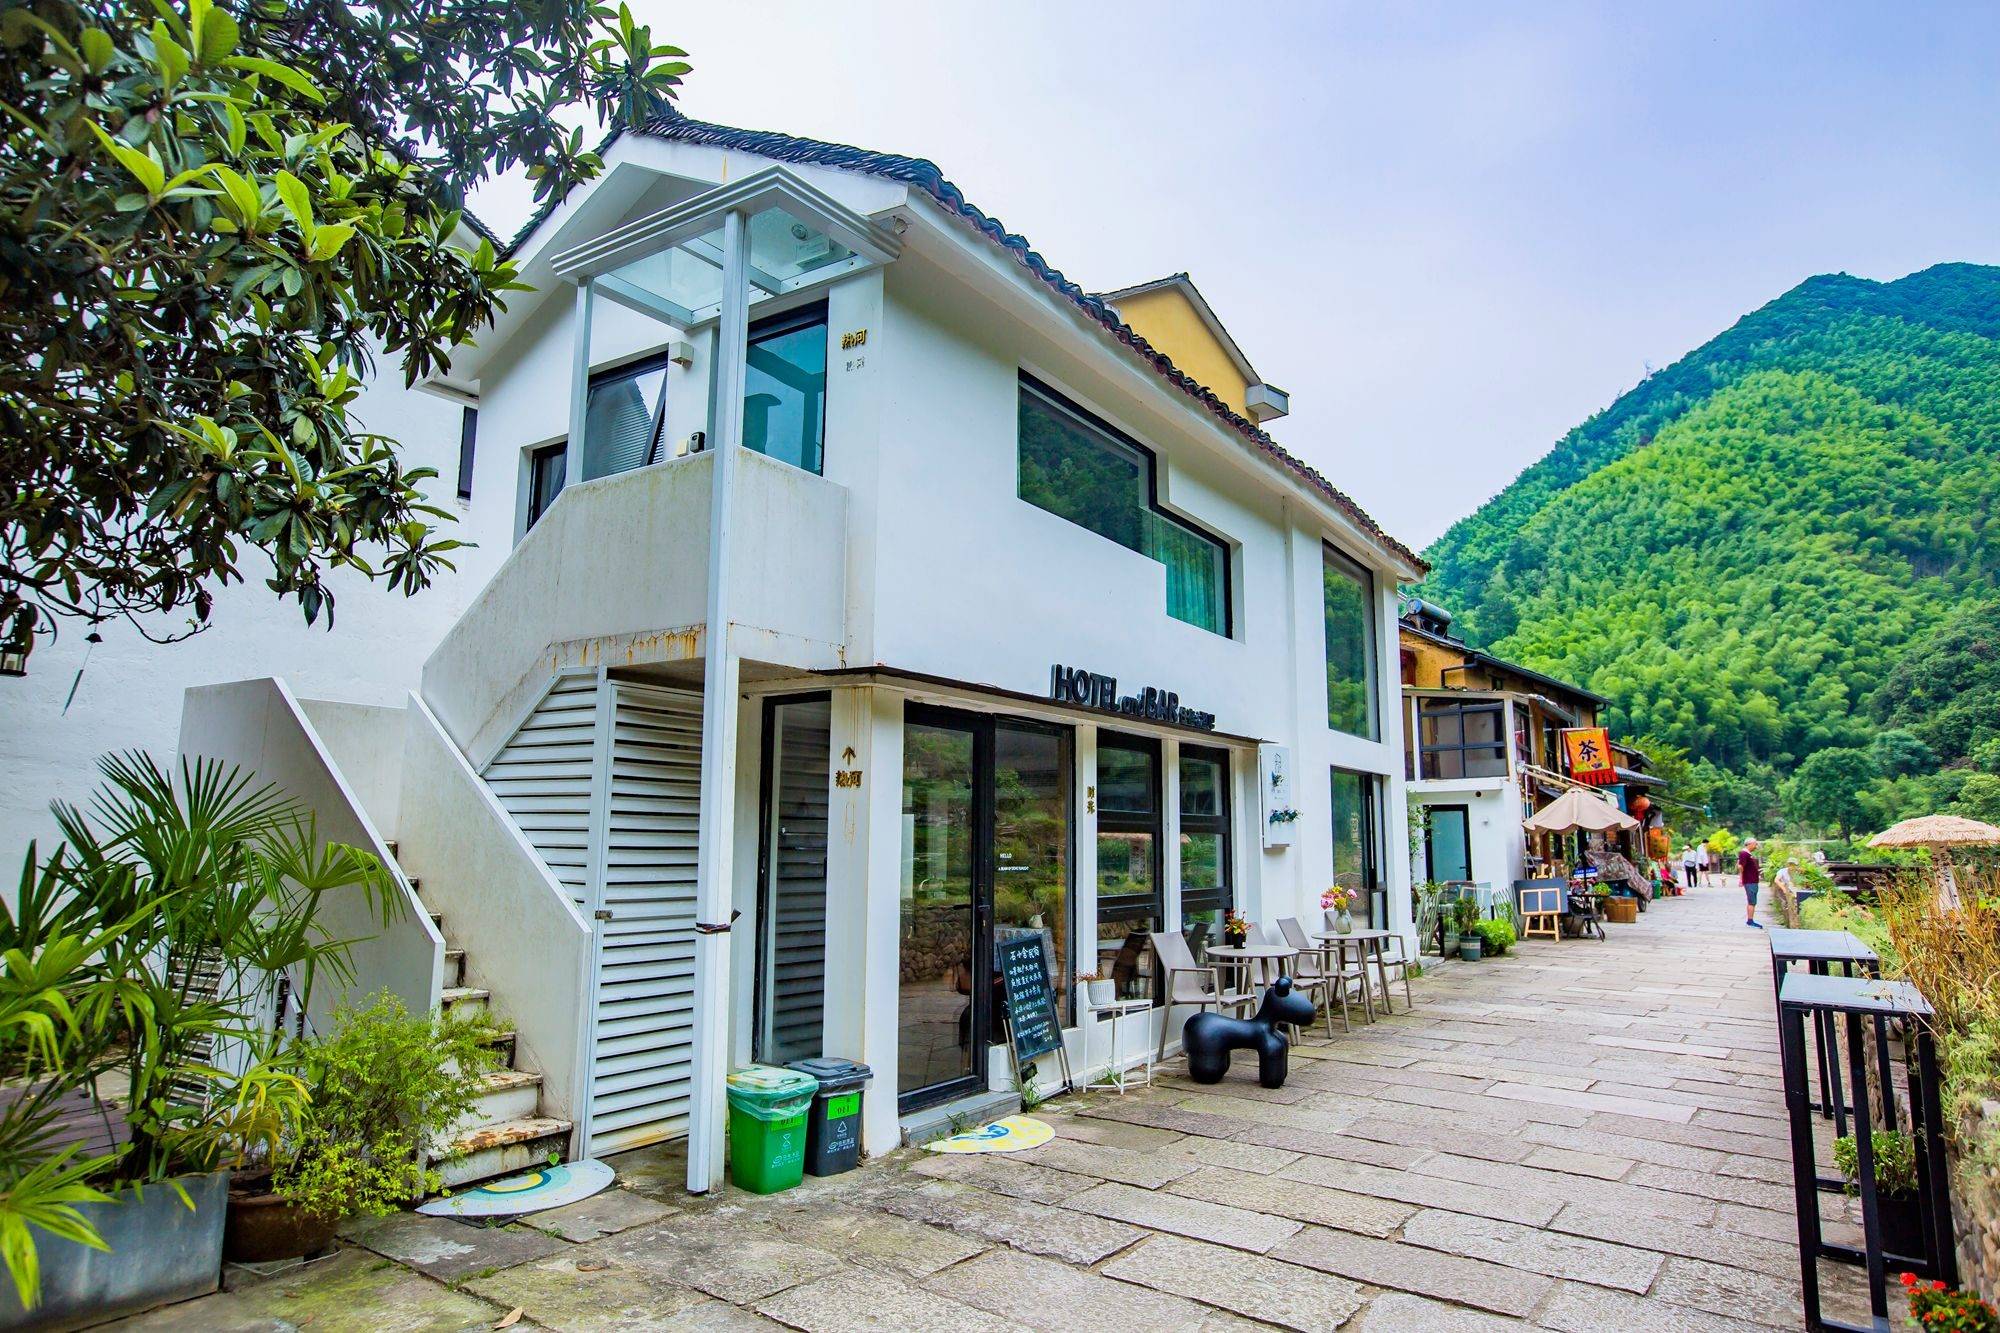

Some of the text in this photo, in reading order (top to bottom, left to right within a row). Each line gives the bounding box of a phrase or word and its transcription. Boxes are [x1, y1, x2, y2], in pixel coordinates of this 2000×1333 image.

[1050, 664, 1119, 710] HOTEL
[1145, 686, 1179, 723] BAR
[1578, 740, 1600, 762] 茶
